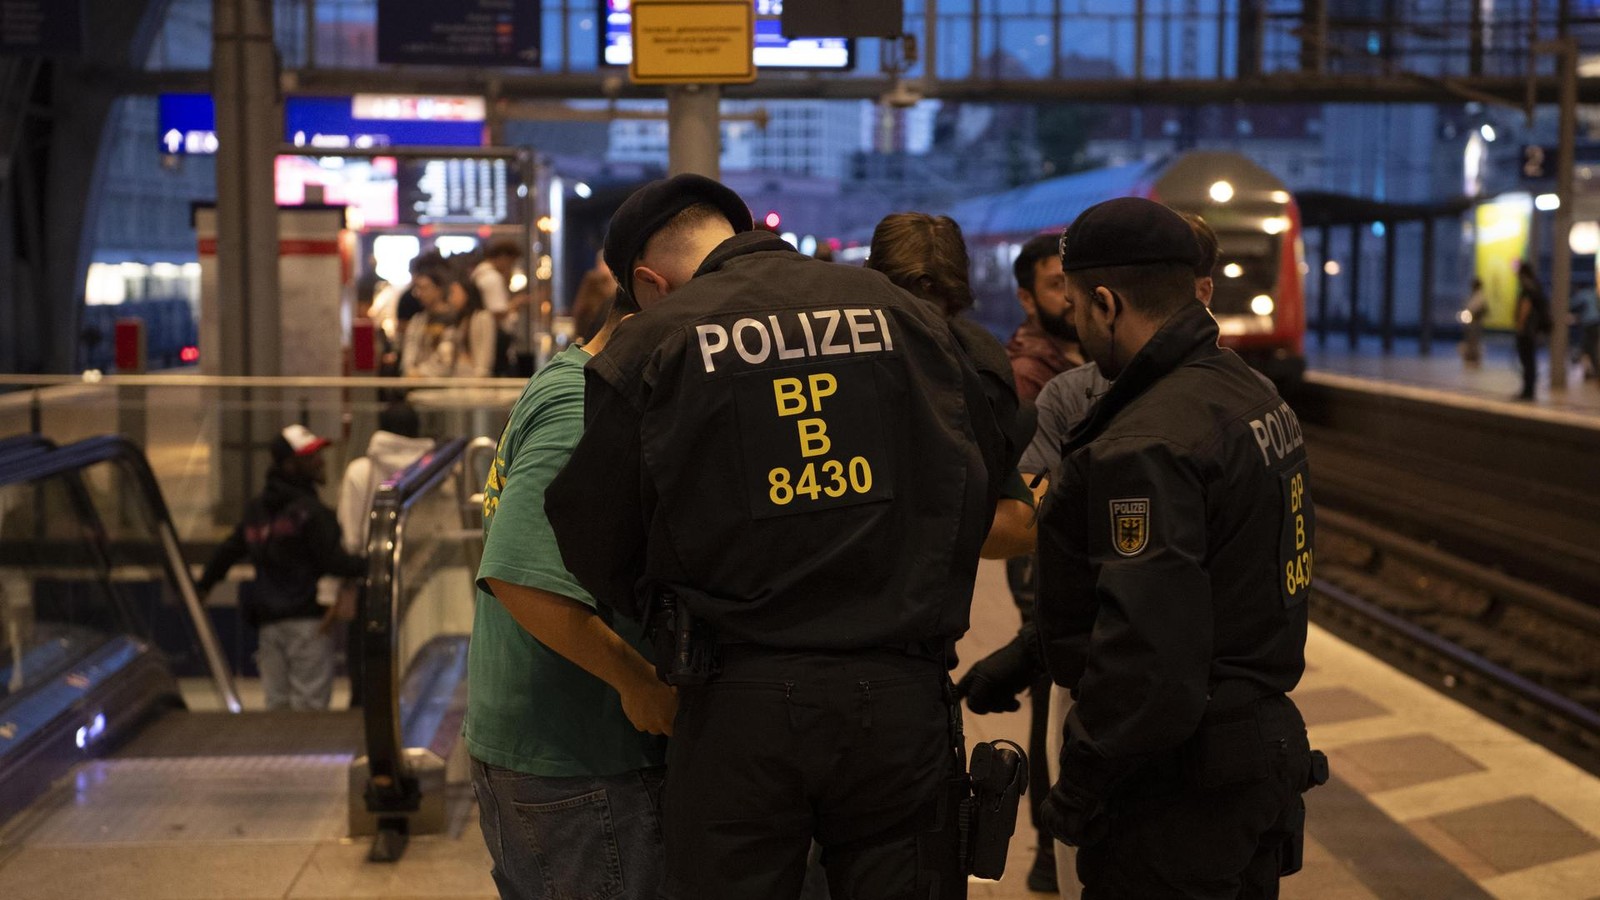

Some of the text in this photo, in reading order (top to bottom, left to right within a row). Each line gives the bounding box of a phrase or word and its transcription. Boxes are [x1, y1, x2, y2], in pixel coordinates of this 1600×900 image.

[1523, 145, 1544, 177] 2
[696, 308, 893, 373] POLIZEI
[773, 373, 838, 417] BP
[797, 417, 832, 458] B
[768, 456, 873, 505] 8430
[1290, 473, 1304, 513] BP
[1114, 502, 1146, 515] POLIZEI
[1295, 514, 1305, 551] B
